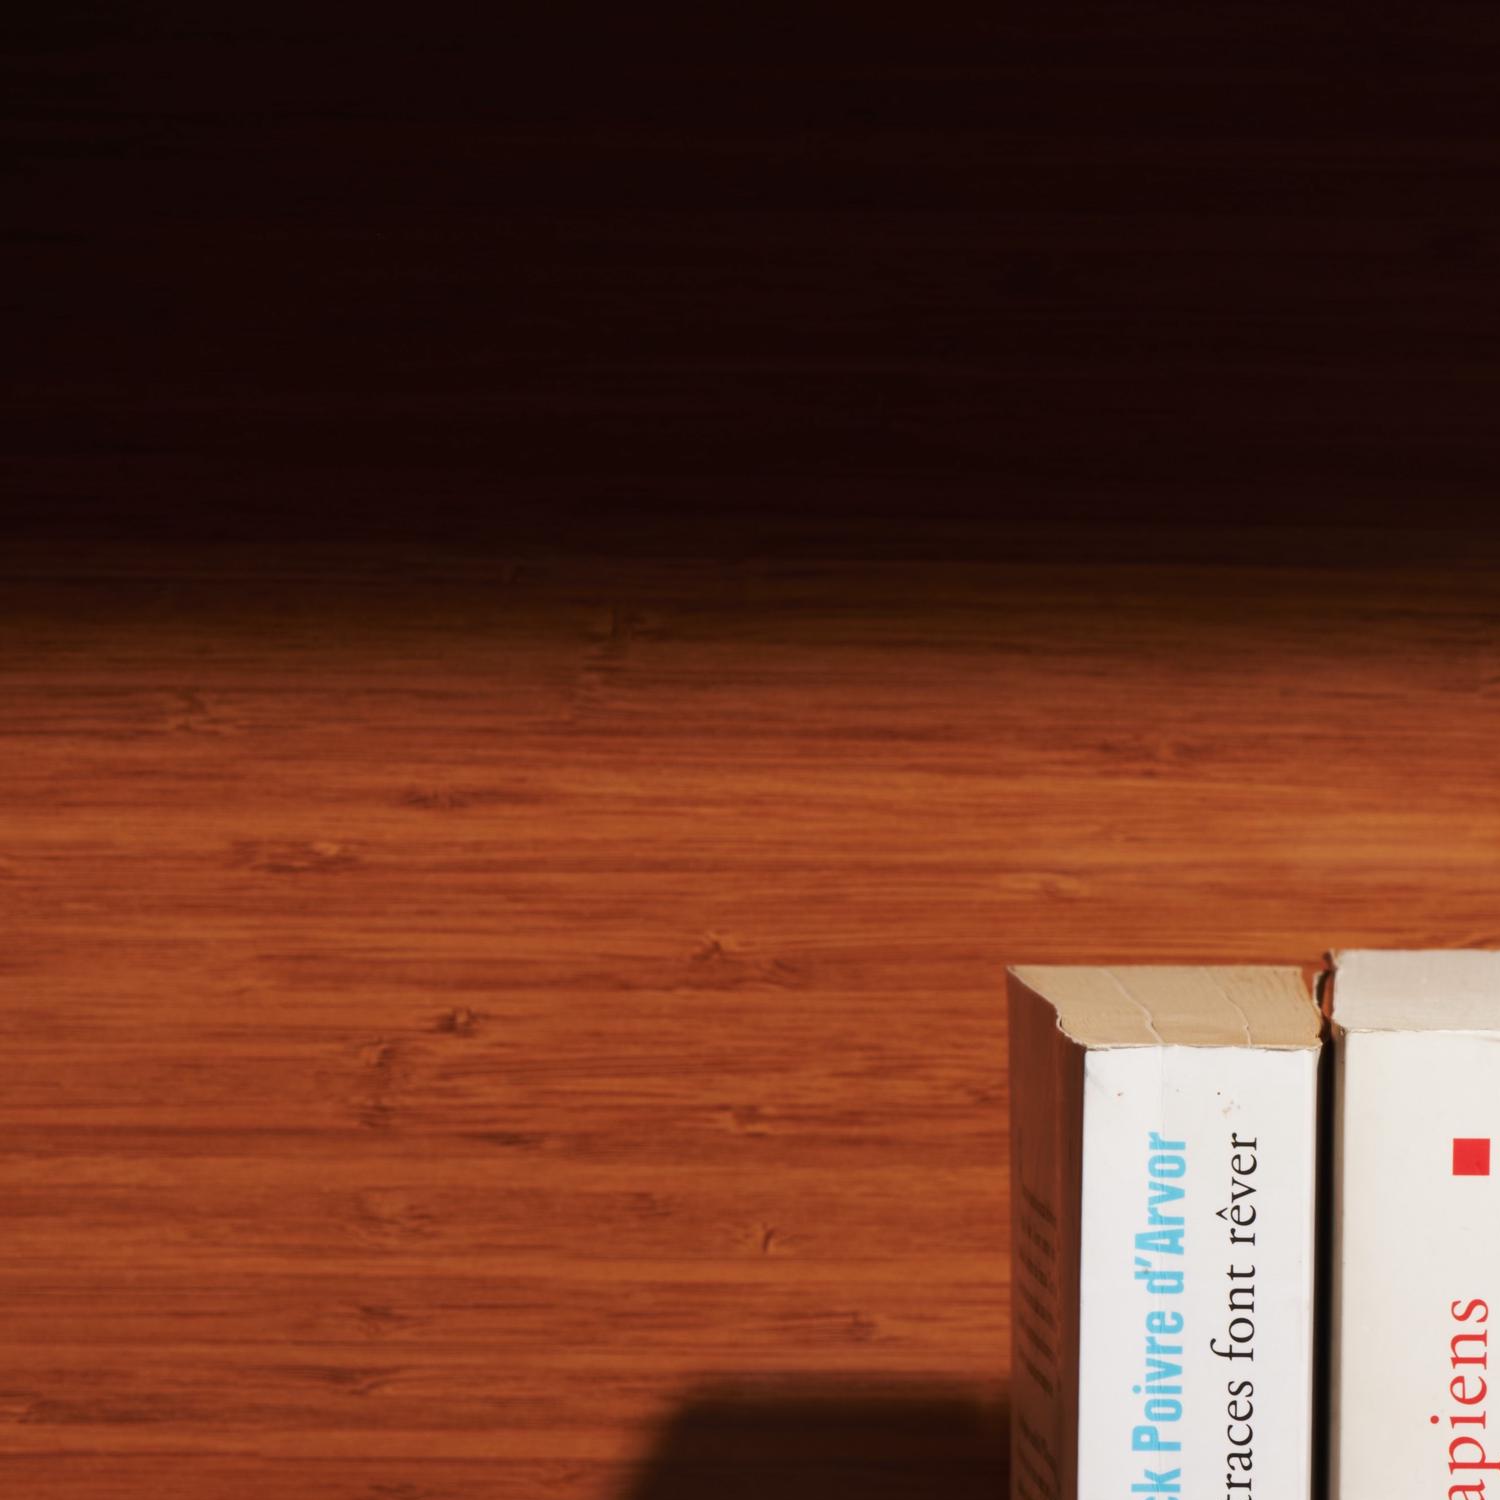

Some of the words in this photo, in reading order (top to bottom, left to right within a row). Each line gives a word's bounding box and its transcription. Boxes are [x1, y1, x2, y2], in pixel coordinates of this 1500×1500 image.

[1216, 1133, 1257, 1245] rêver
[1210, 1265, 1255, 1360] font
[1133, 1312, 1183, 1451] Poivre
